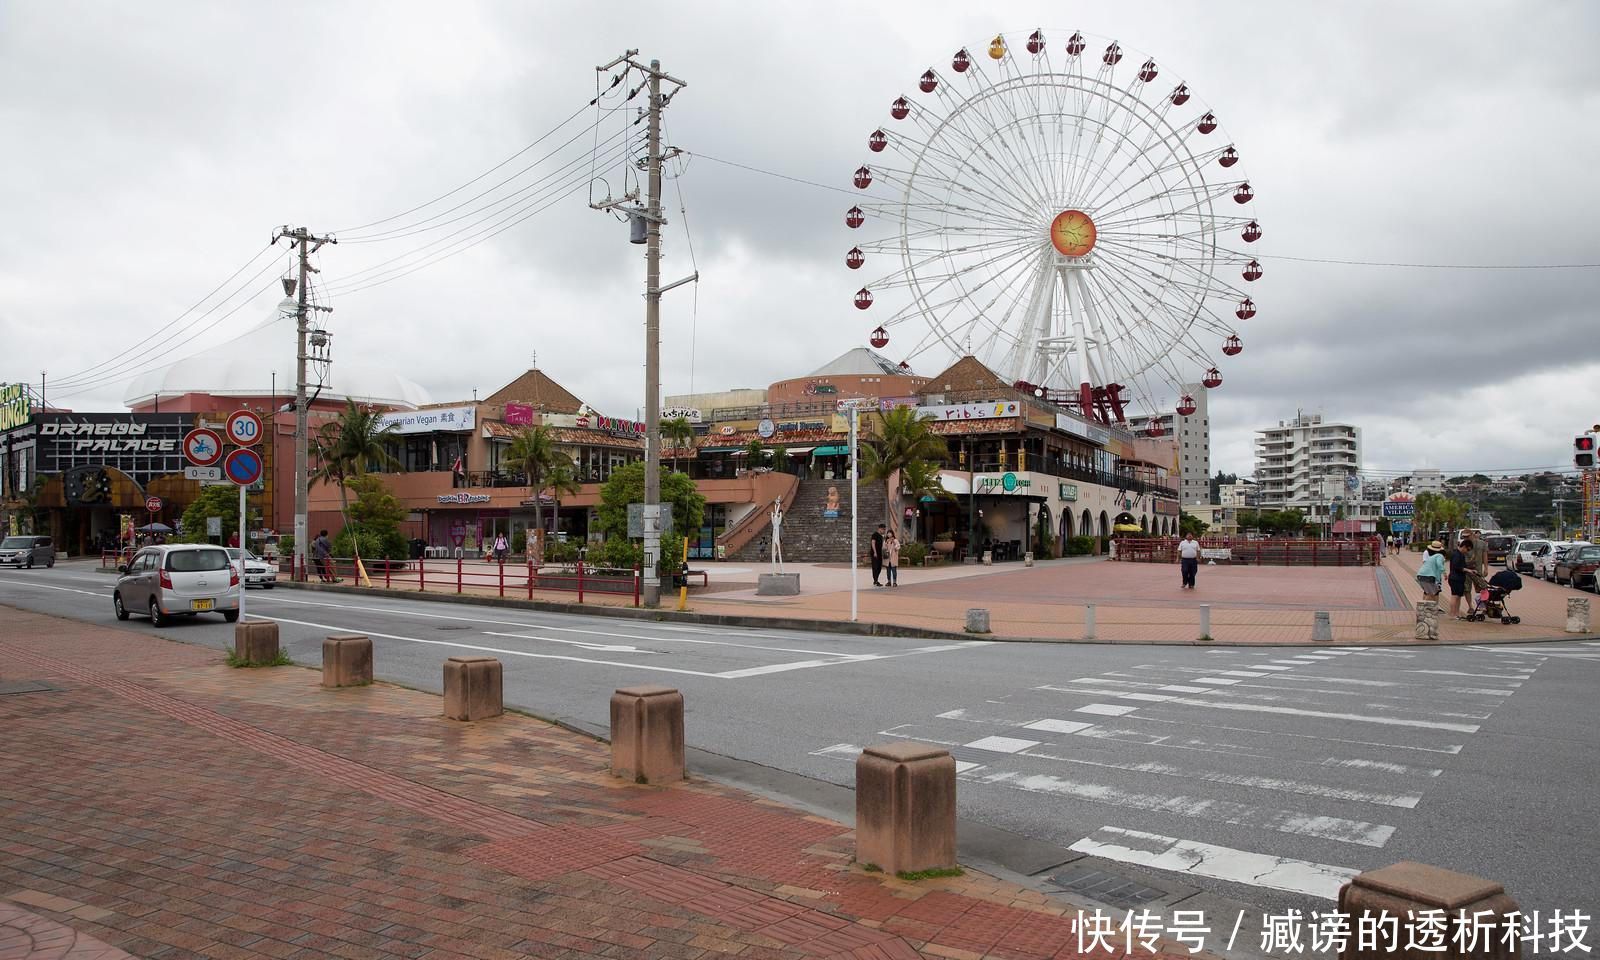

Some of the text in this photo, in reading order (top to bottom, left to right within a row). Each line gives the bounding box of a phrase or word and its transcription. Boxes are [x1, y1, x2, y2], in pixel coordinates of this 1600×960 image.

[416, 415, 437, 426] Vegan
[440, 412, 456, 423] 素食
[945, 406, 986, 419] rib's
[40, 423, 147, 435] DRAGON
[235, 420, 255, 437] 30
[597, 416, 646, 433] PARTYLAN
[76, 439, 176, 451] PALACE
